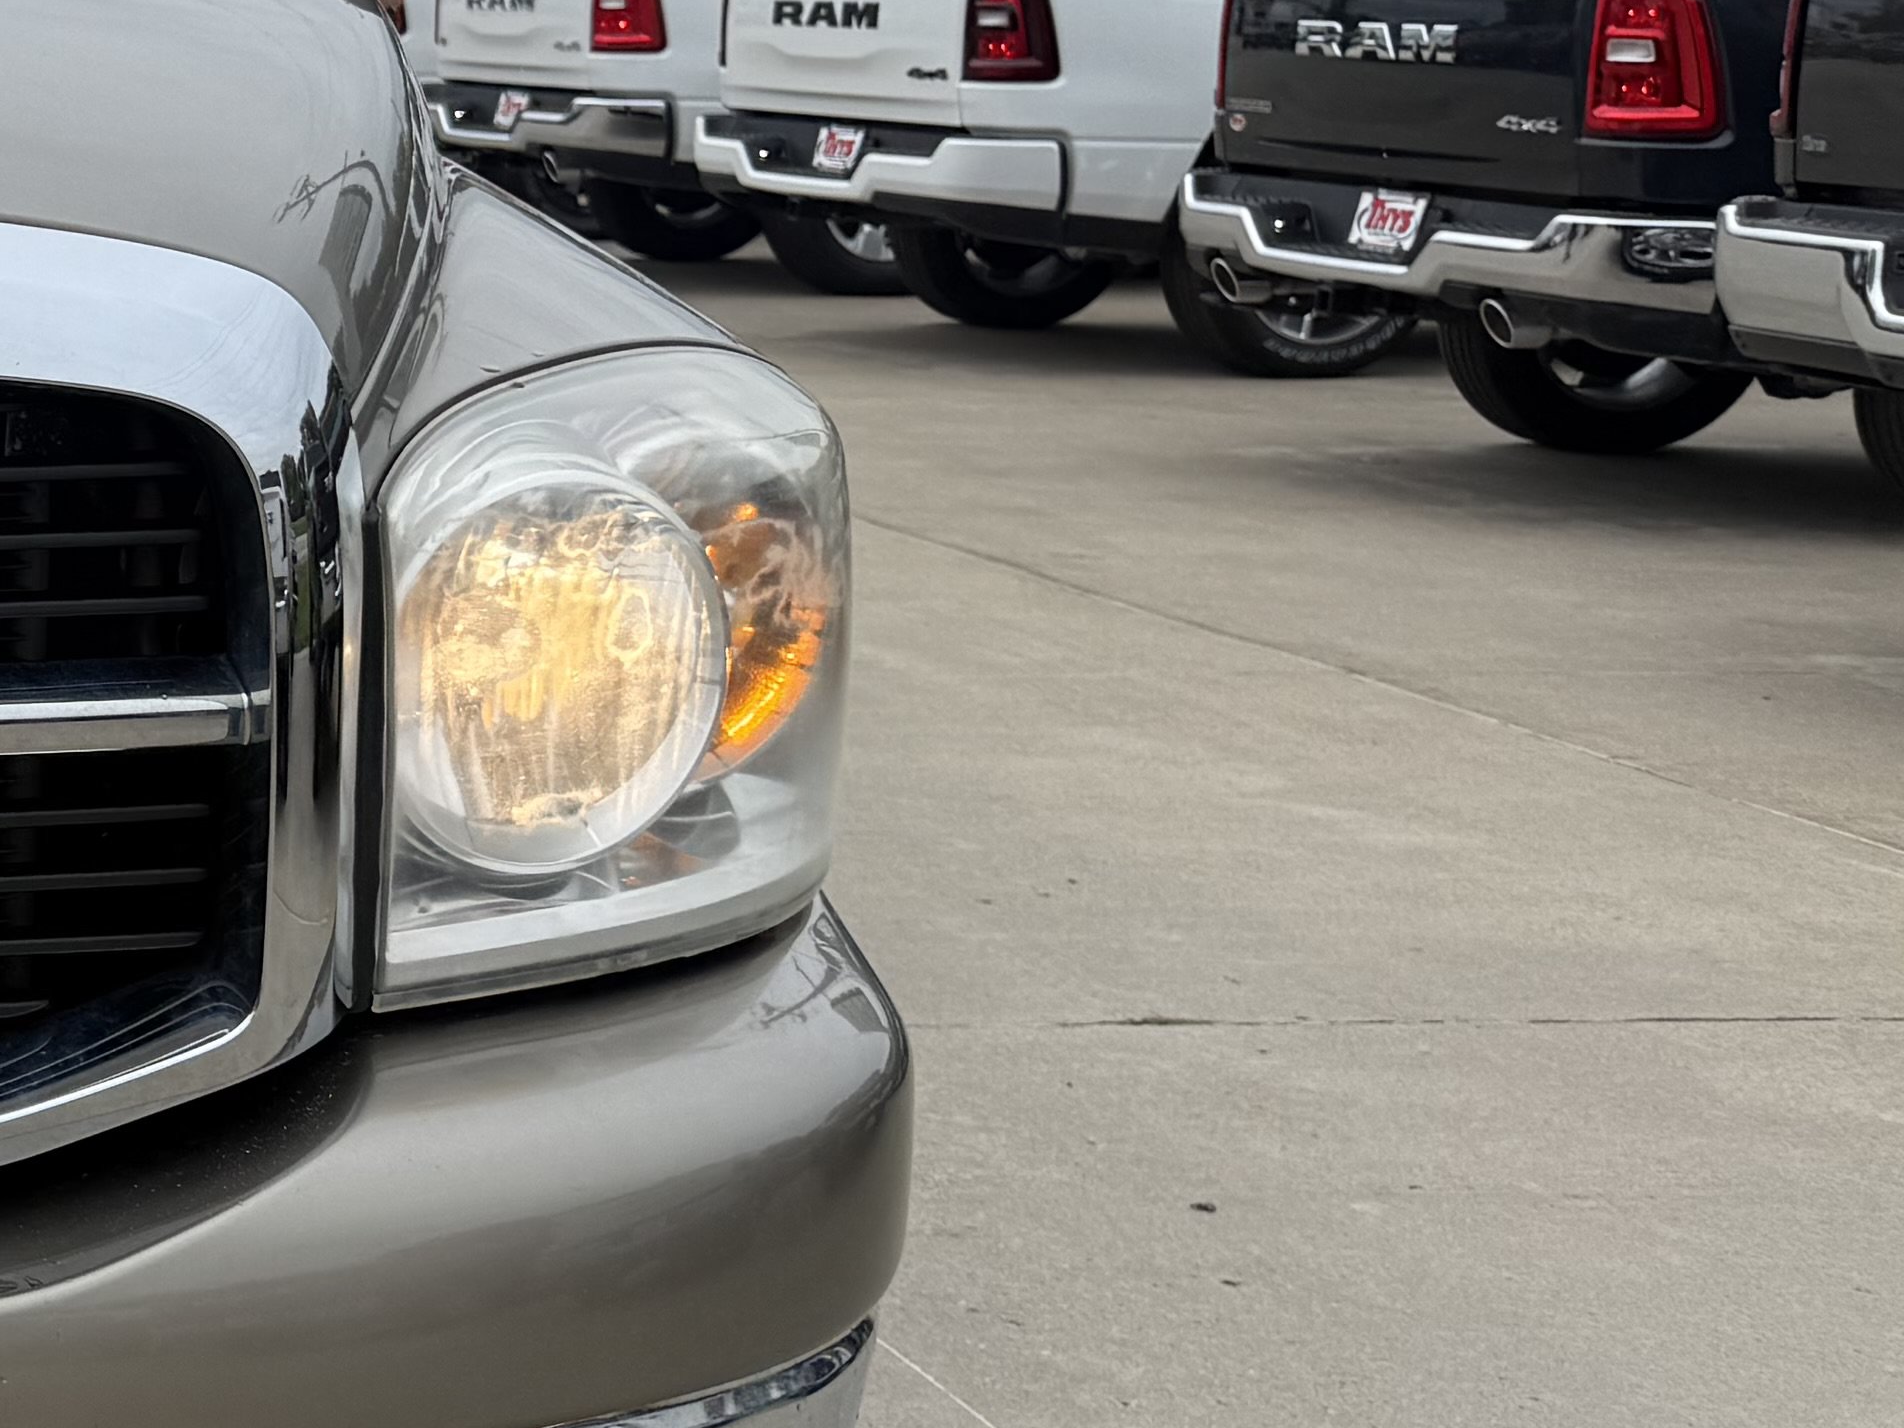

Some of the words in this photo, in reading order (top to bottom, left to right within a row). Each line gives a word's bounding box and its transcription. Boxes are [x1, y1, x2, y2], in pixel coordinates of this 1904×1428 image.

[772, 0, 880, 29] RAM
[1294, 19, 1459, 63] RAM
[1496, 114, 1562, 133] 4x4
